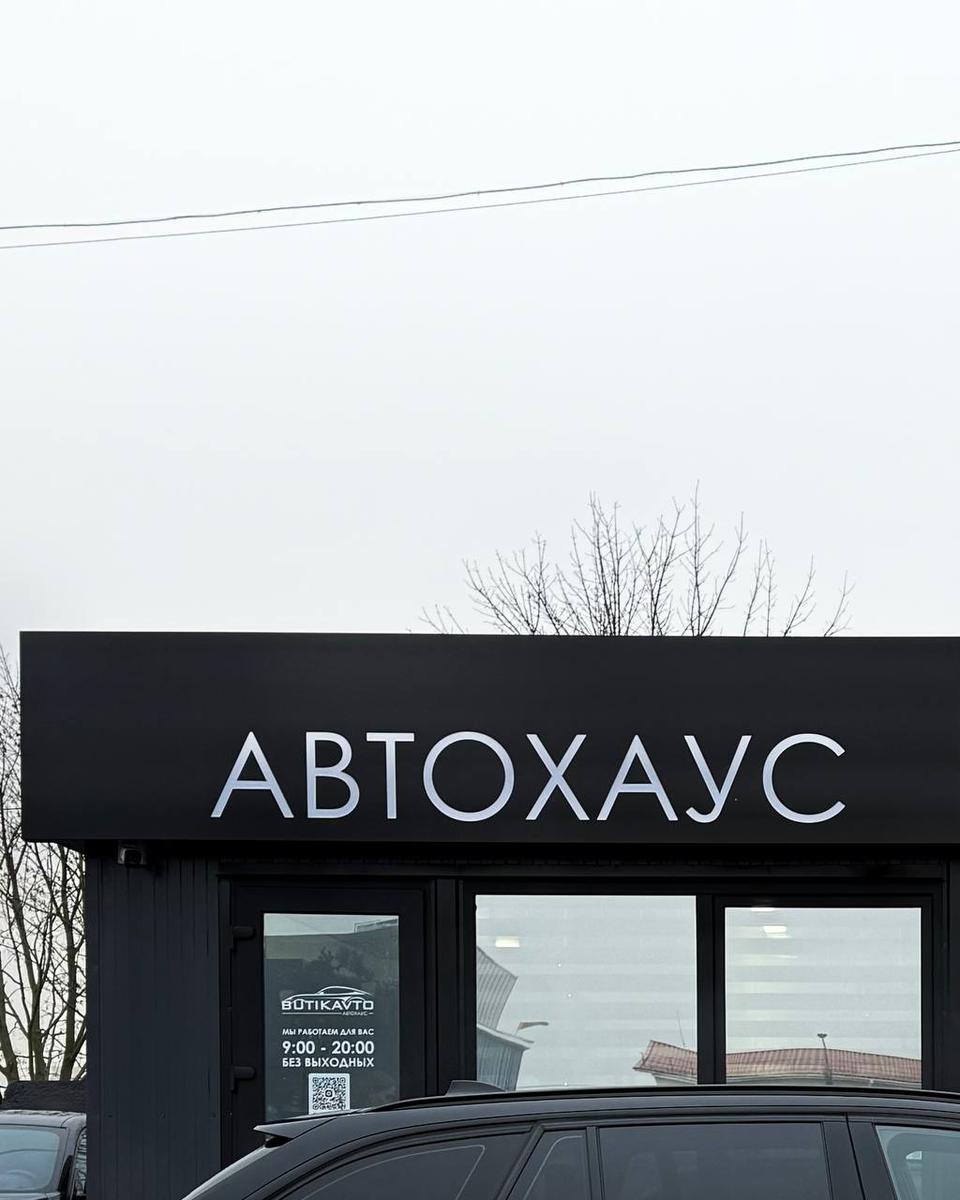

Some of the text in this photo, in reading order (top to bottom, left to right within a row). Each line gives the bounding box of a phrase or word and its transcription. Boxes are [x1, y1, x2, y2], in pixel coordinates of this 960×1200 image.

[211, 731, 846, 824] АВТОХАУС
[281, 1000, 374, 1010] BUTIKAVTO
[340, 1028, 356, 1036] ДЛЯ
[282, 1041, 315, 1054] 9:00
[332, 1041, 374, 1054] 20:00
[282, 1057, 375, 1068] БЕЗ ВЫХОДНЫХ
